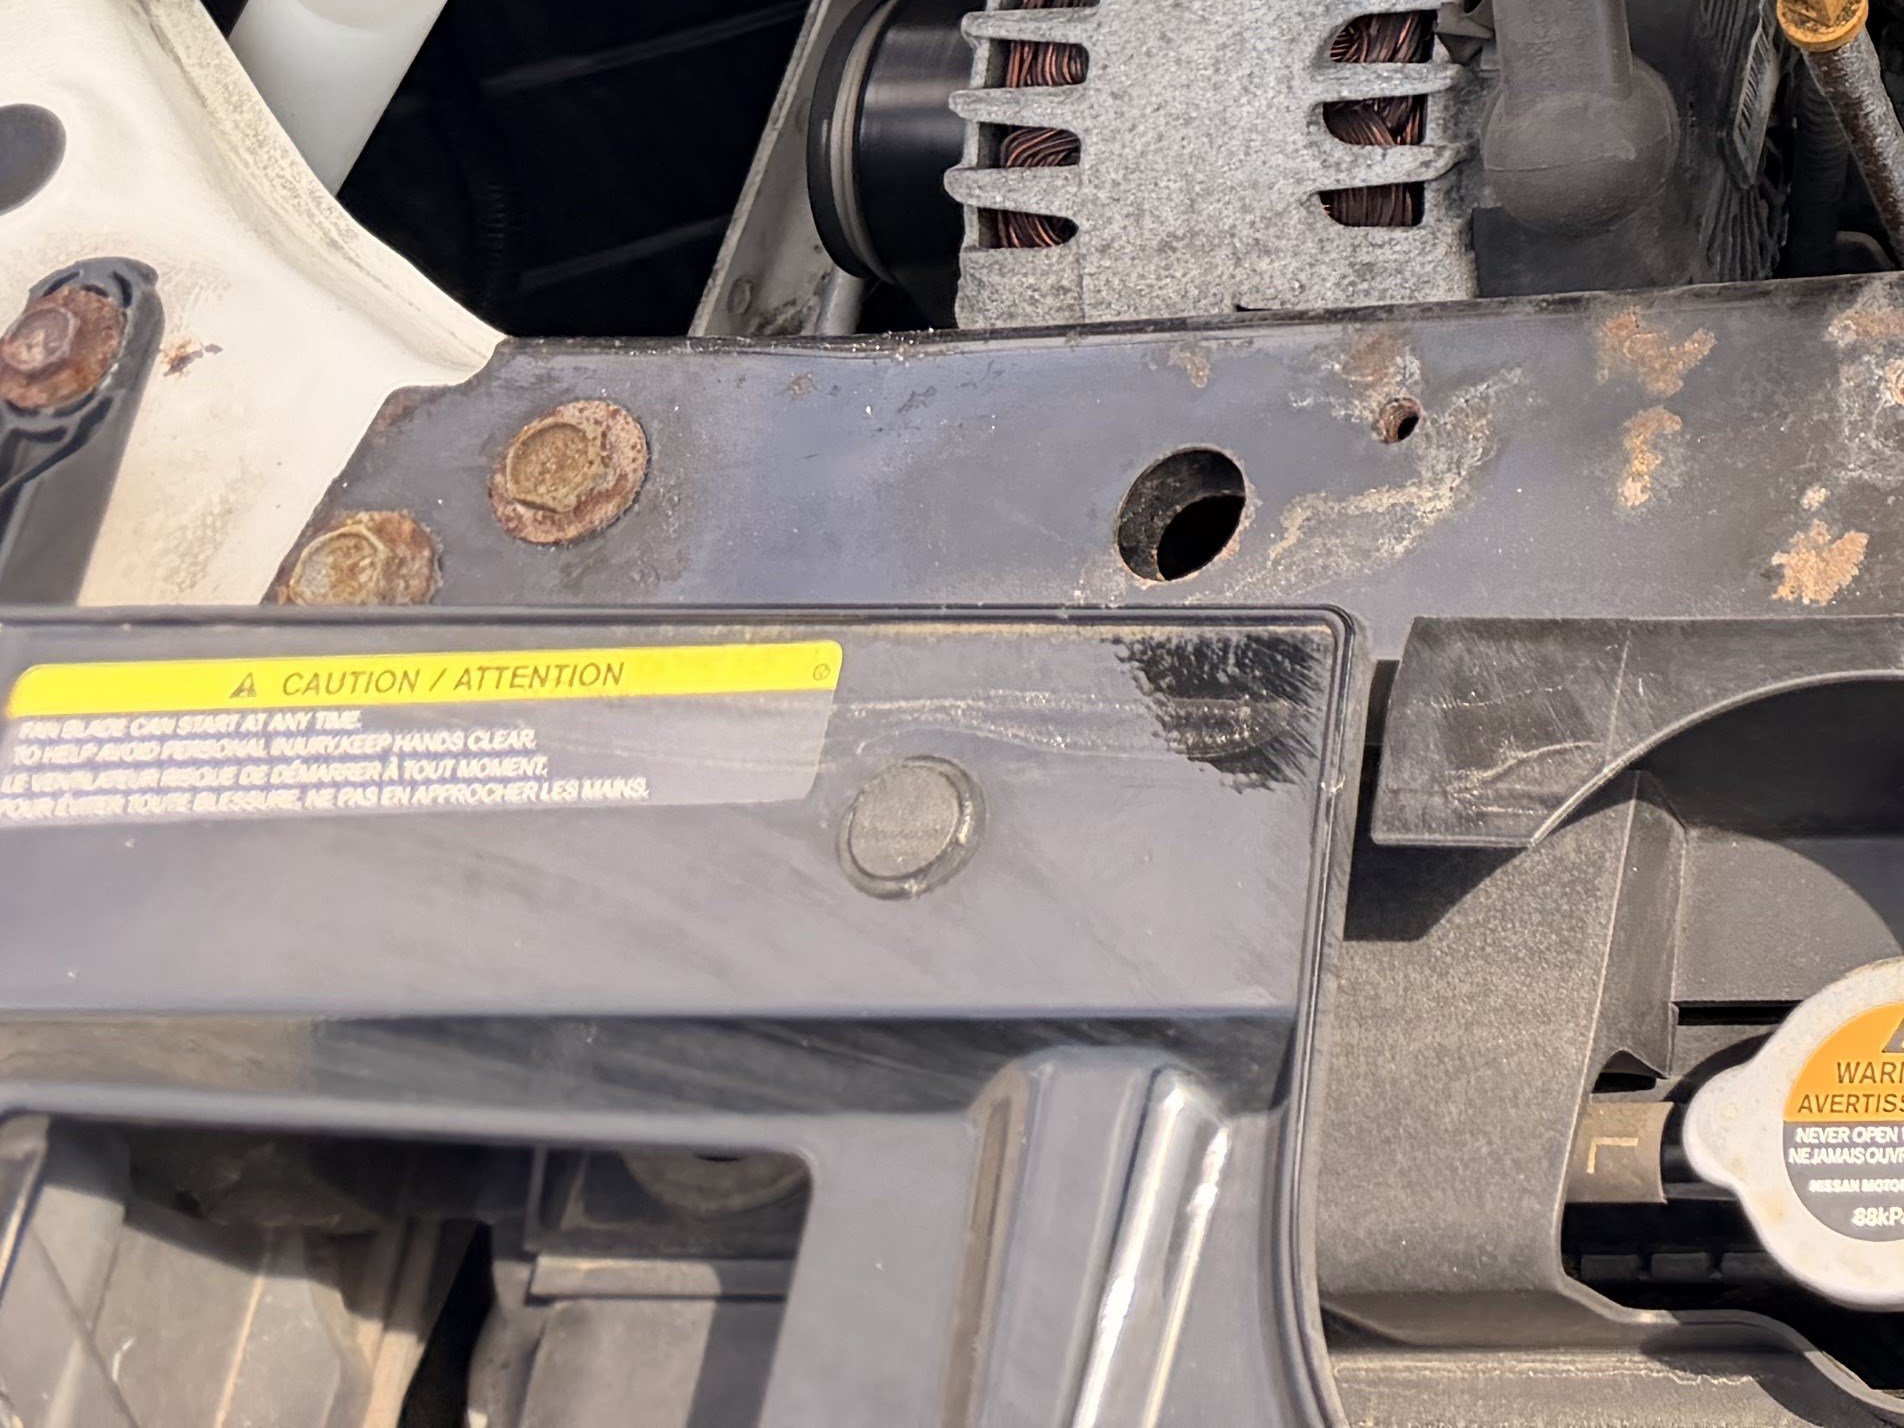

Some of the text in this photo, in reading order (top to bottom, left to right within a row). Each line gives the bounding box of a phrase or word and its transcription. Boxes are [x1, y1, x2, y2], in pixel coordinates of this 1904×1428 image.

[282, 660, 625, 697] CAUTION / ATTENTION
[18, 717, 59, 741] FAN
[61, 717, 128, 739] BLADE
[130, 714, 176, 738] CAN
[175, 713, 241, 735] START
[241, 711, 267, 733] AT
[268, 711, 312, 733] ANY
[14, 744, 42, 768] TO
[44, 742, 97, 765] HELP
[96, 739, 160, 763] AVOID
[160, 735, 269, 760] PERSONAL
[398, 728, 465, 753] HANDS
[1, 772, 30, 795] LE
[239, 762, 270, 786] DE
[402, 756, 456, 780] TOUT
[304, 786, 337, 809] NE
[337, 785, 380, 808] PAS
[380, 783, 412, 805] EN
[411, 779, 539, 804] APPROCHER
[539, 778, 578, 801] LES
[1796, 1125, 1850, 1143] NEVER
[1852, 1125, 1899, 1143] OPEN
[1788, 1146, 1812, 1164] NE
[1811, 1146, 1865, 1164] JAMAIS
[1808, 1178, 1860, 1194] NISSAN
